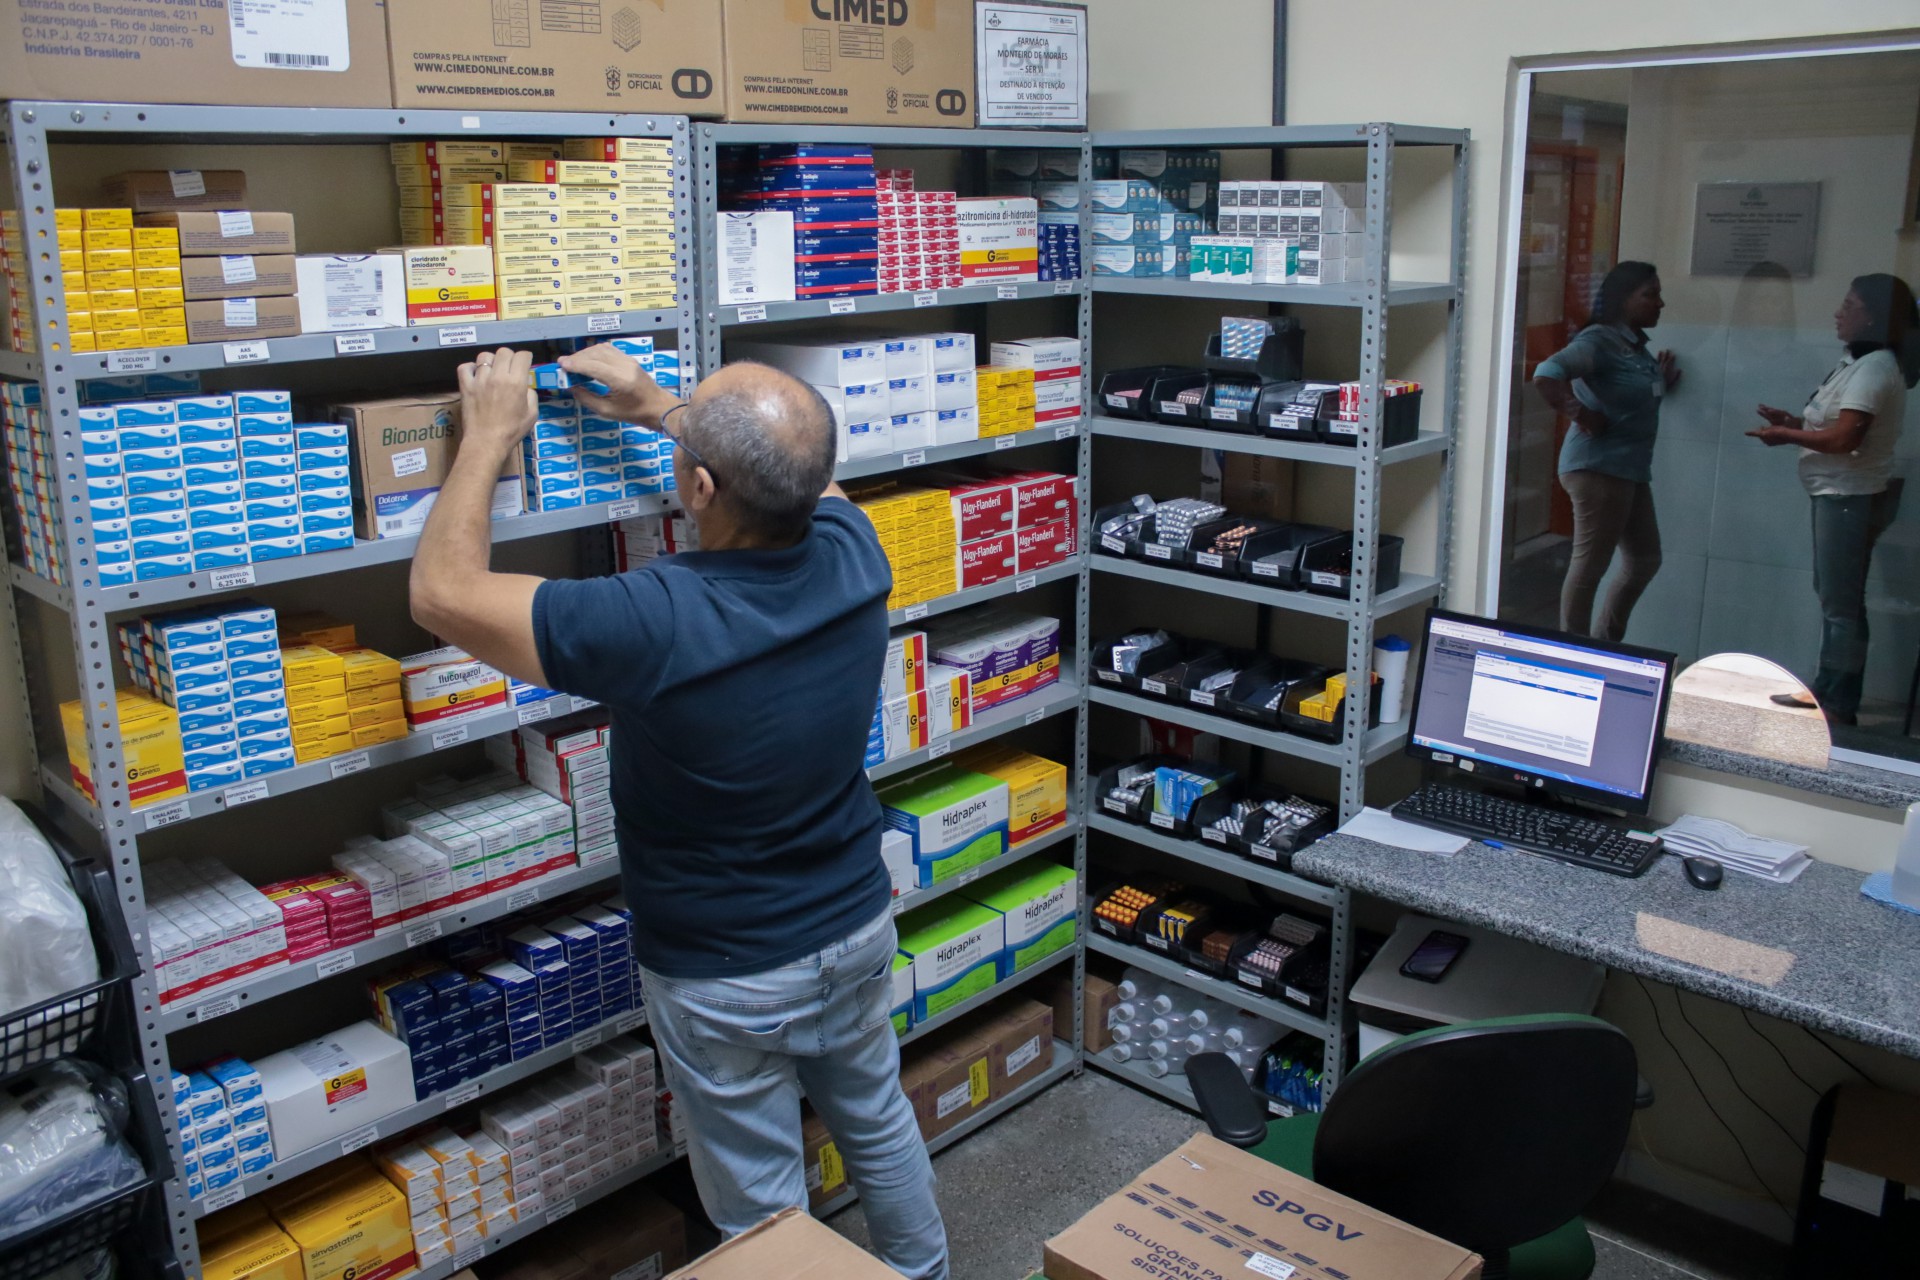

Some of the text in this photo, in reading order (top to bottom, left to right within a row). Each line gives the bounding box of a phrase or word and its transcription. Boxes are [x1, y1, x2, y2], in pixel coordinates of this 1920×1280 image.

[18, 0, 198, 20] Estrada dos Bandeirantes, 4211
[810, 0, 908, 26] CIMED
[20, 12, 98, 28] Jacarepaguá
[111, 19, 129, 30] Rio
[132, 20, 146, 30] de
[150, 22, 188, 34] Janeiro
[200, 25, 214, 35] RJ
[22, 27, 72, 41] C.N.P.J.
[76, 32, 138, 44] 42.374.207
[150, 36, 193, 48] 0001-76
[1018, 36, 1049, 46] FARMÁCIA
[24, 42, 140, 60] Indústria Brasileira
[413, 52, 507, 63] COMPRAS PELA INTERNET
[998, 50, 1068, 60] MONTEIRO DE MORAES
[414, 63, 554, 76] WWW.CIMEDONLINE.COM.BR
[416, 85, 555, 97] WWW.CIMEDREMEDIOS.COM.BR
[628, 80, 663, 90] OFICIAL
[744, 85, 848, 96] WWW.CIMEDONLINE.COM.BR
[1039, 81, 1065, 90] RETENÇÃO
[903, 99, 929, 108] OFICIAL
[1026, 93, 1052, 101] VENCIDOS
[745, 104, 848, 114] WWW.CIMEDREMEDIOS.COM.BR
[958, 210, 1036, 222] azitromicina di-hidratada
[1017, 228, 1036, 238] 500 mg
[382, 424, 455, 446] Bionatus
[393, 451, 421, 461] MONTEIRO
[398, 461, 421, 469] MORAES
[1020, 483, 1055, 502] Algy-Flanderil
[963, 494, 1001, 514] Algy-Flanderil
[1019, 527, 1054, 546] Algy-Flanderil
[964, 540, 1002, 562] Algy-Flanderil
[139, 730, 164, 743] enalapril
[153, 808, 183, 819] ENALAPRIL
[943, 800, 987, 826] Hidraplex
[1025, 892, 1064, 918] Hidraplex
[937, 934, 981, 962] Hidraplex
[1252, 1189, 1365, 1242] SPGV
[311, 1231, 363, 1259] sinvastatina
[1114, 1222, 1200, 1270] SOLUÇÕES
[233, 1247, 290, 1274] sinvastatina
